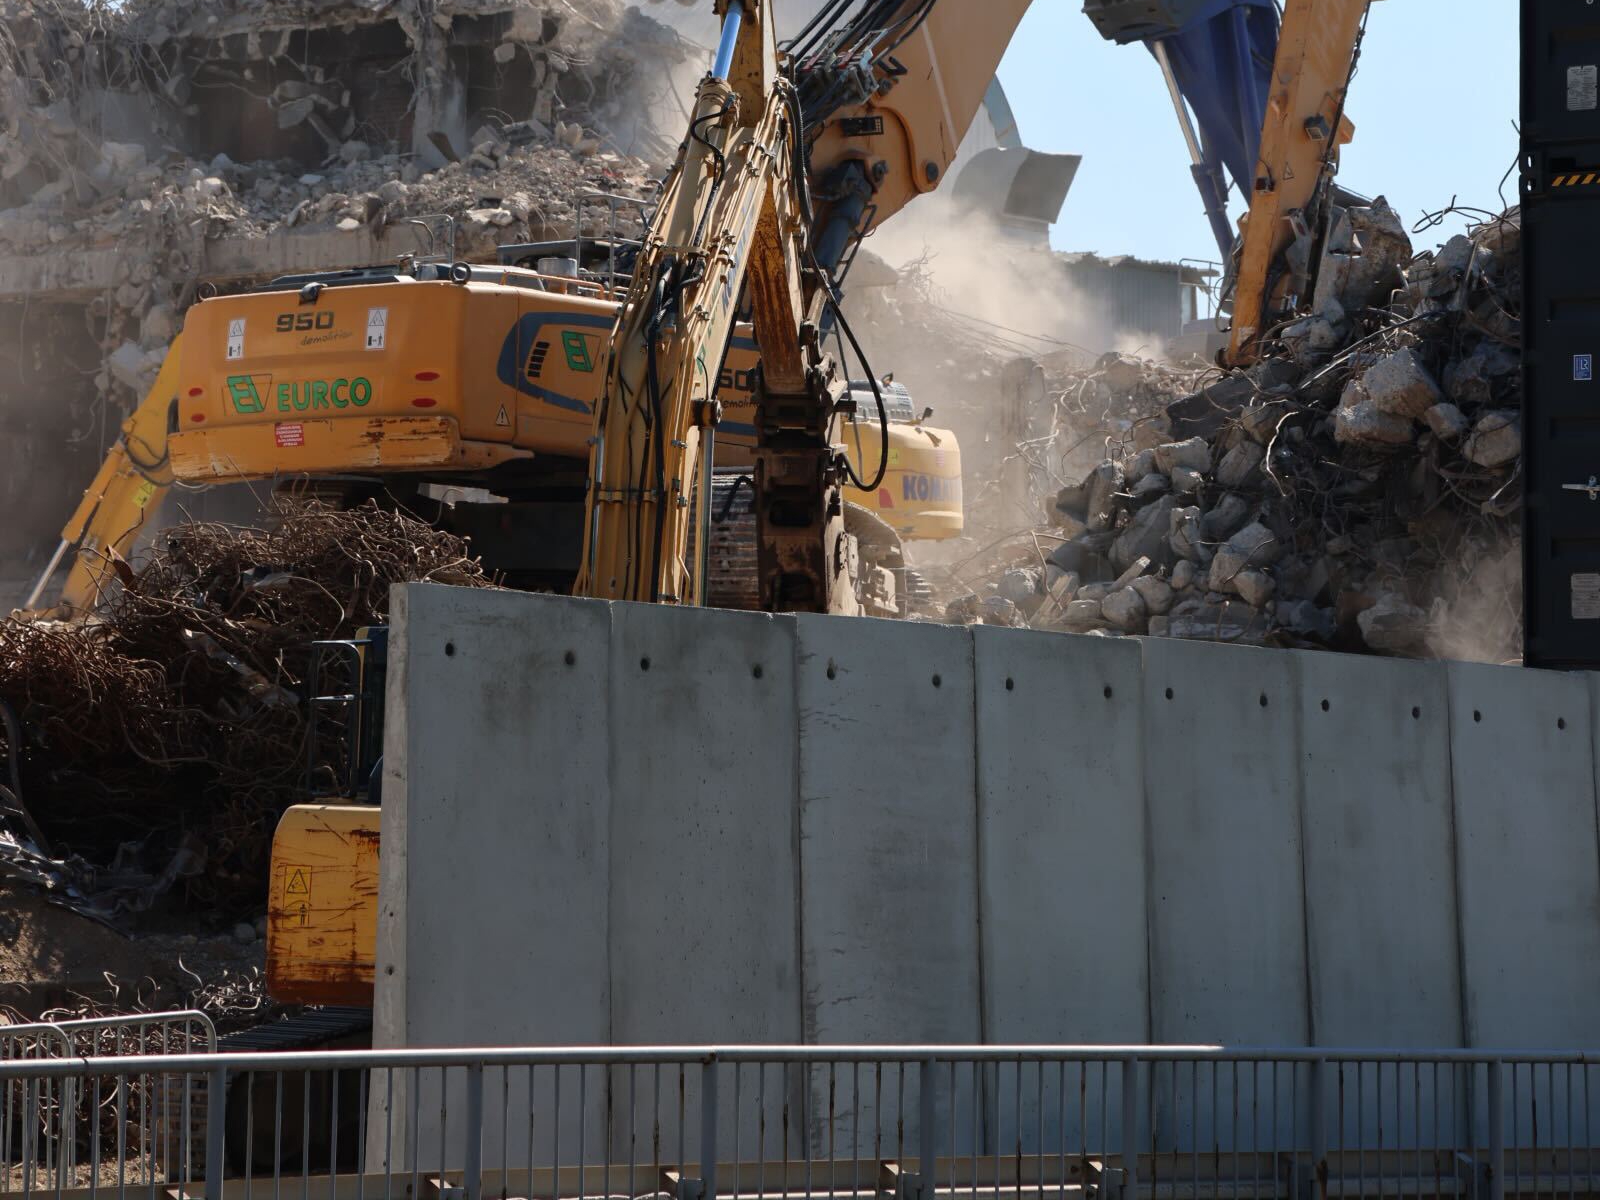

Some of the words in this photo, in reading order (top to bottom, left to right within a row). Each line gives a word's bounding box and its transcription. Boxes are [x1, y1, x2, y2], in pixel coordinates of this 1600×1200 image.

[276, 311, 335, 332] 950
[718, 368, 755, 391] 50
[277, 377, 372, 412] EURCO
